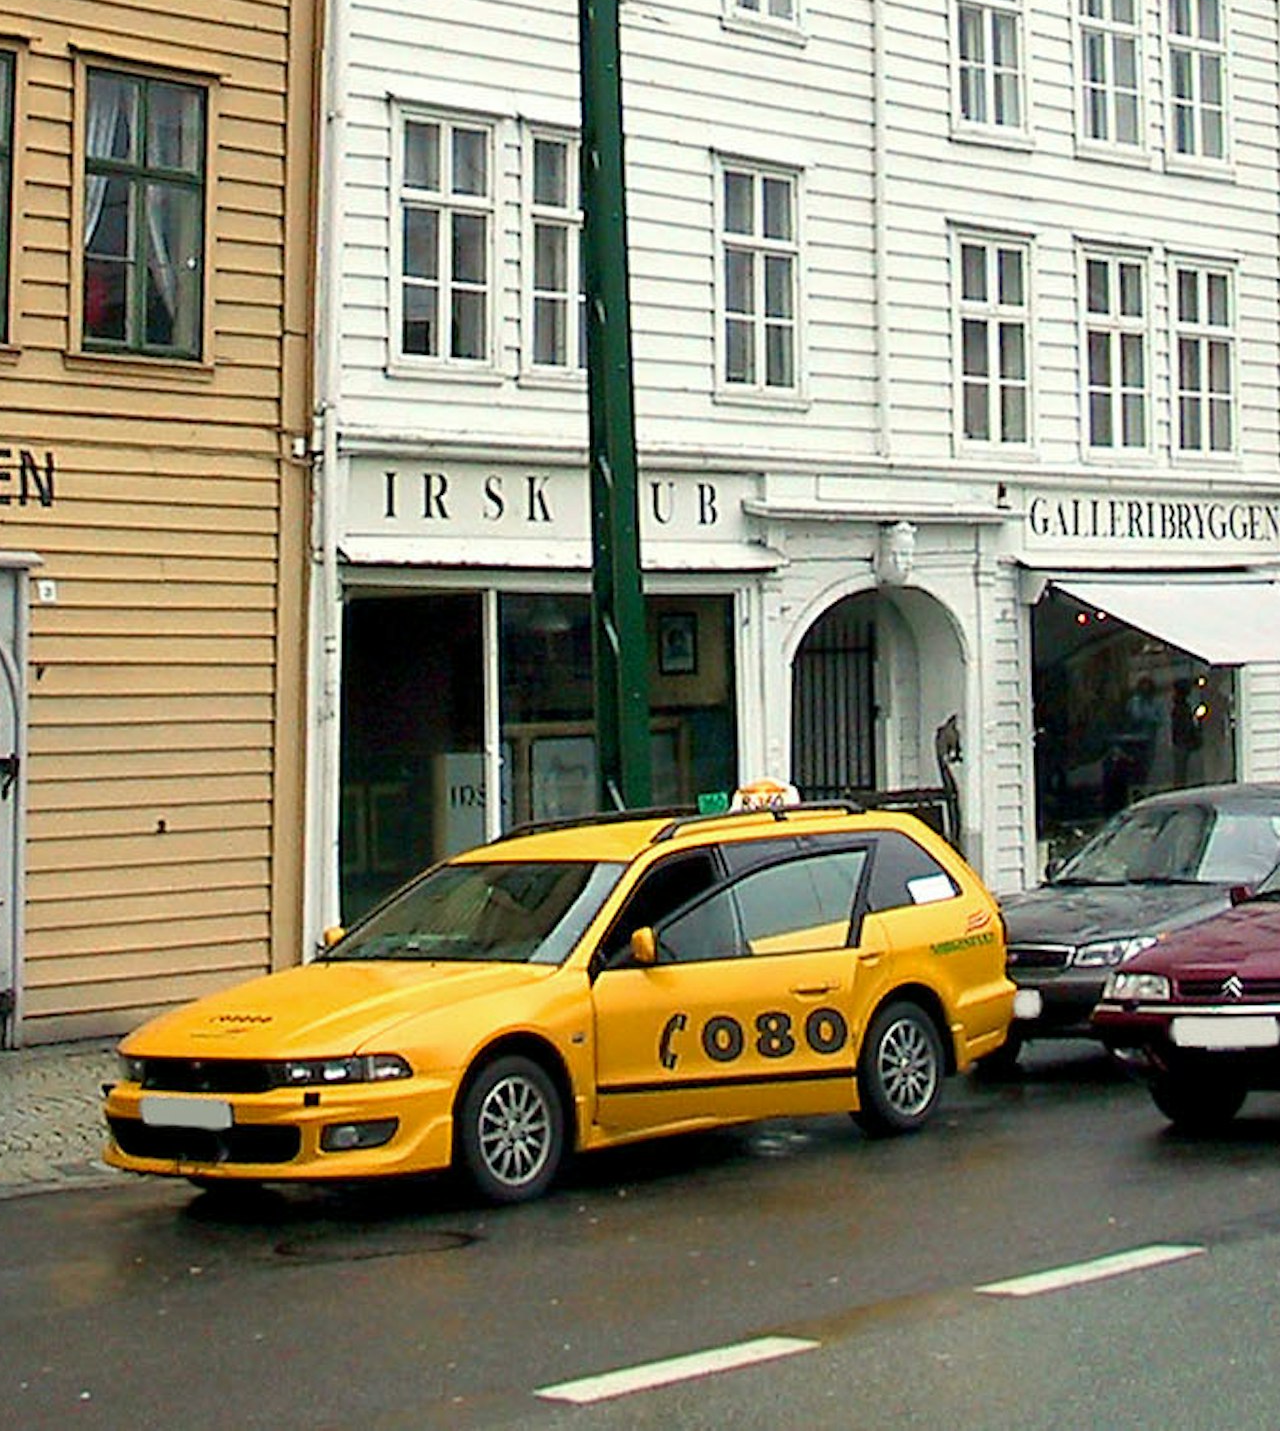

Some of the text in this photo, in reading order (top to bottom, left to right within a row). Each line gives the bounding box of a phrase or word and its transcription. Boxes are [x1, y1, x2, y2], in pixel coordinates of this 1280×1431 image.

[382, 472, 719, 526] IRSK UB
[1029, 497, 1280, 542] GALLERI BRYGGEN
[701, 1007, 848, 1062] 080
